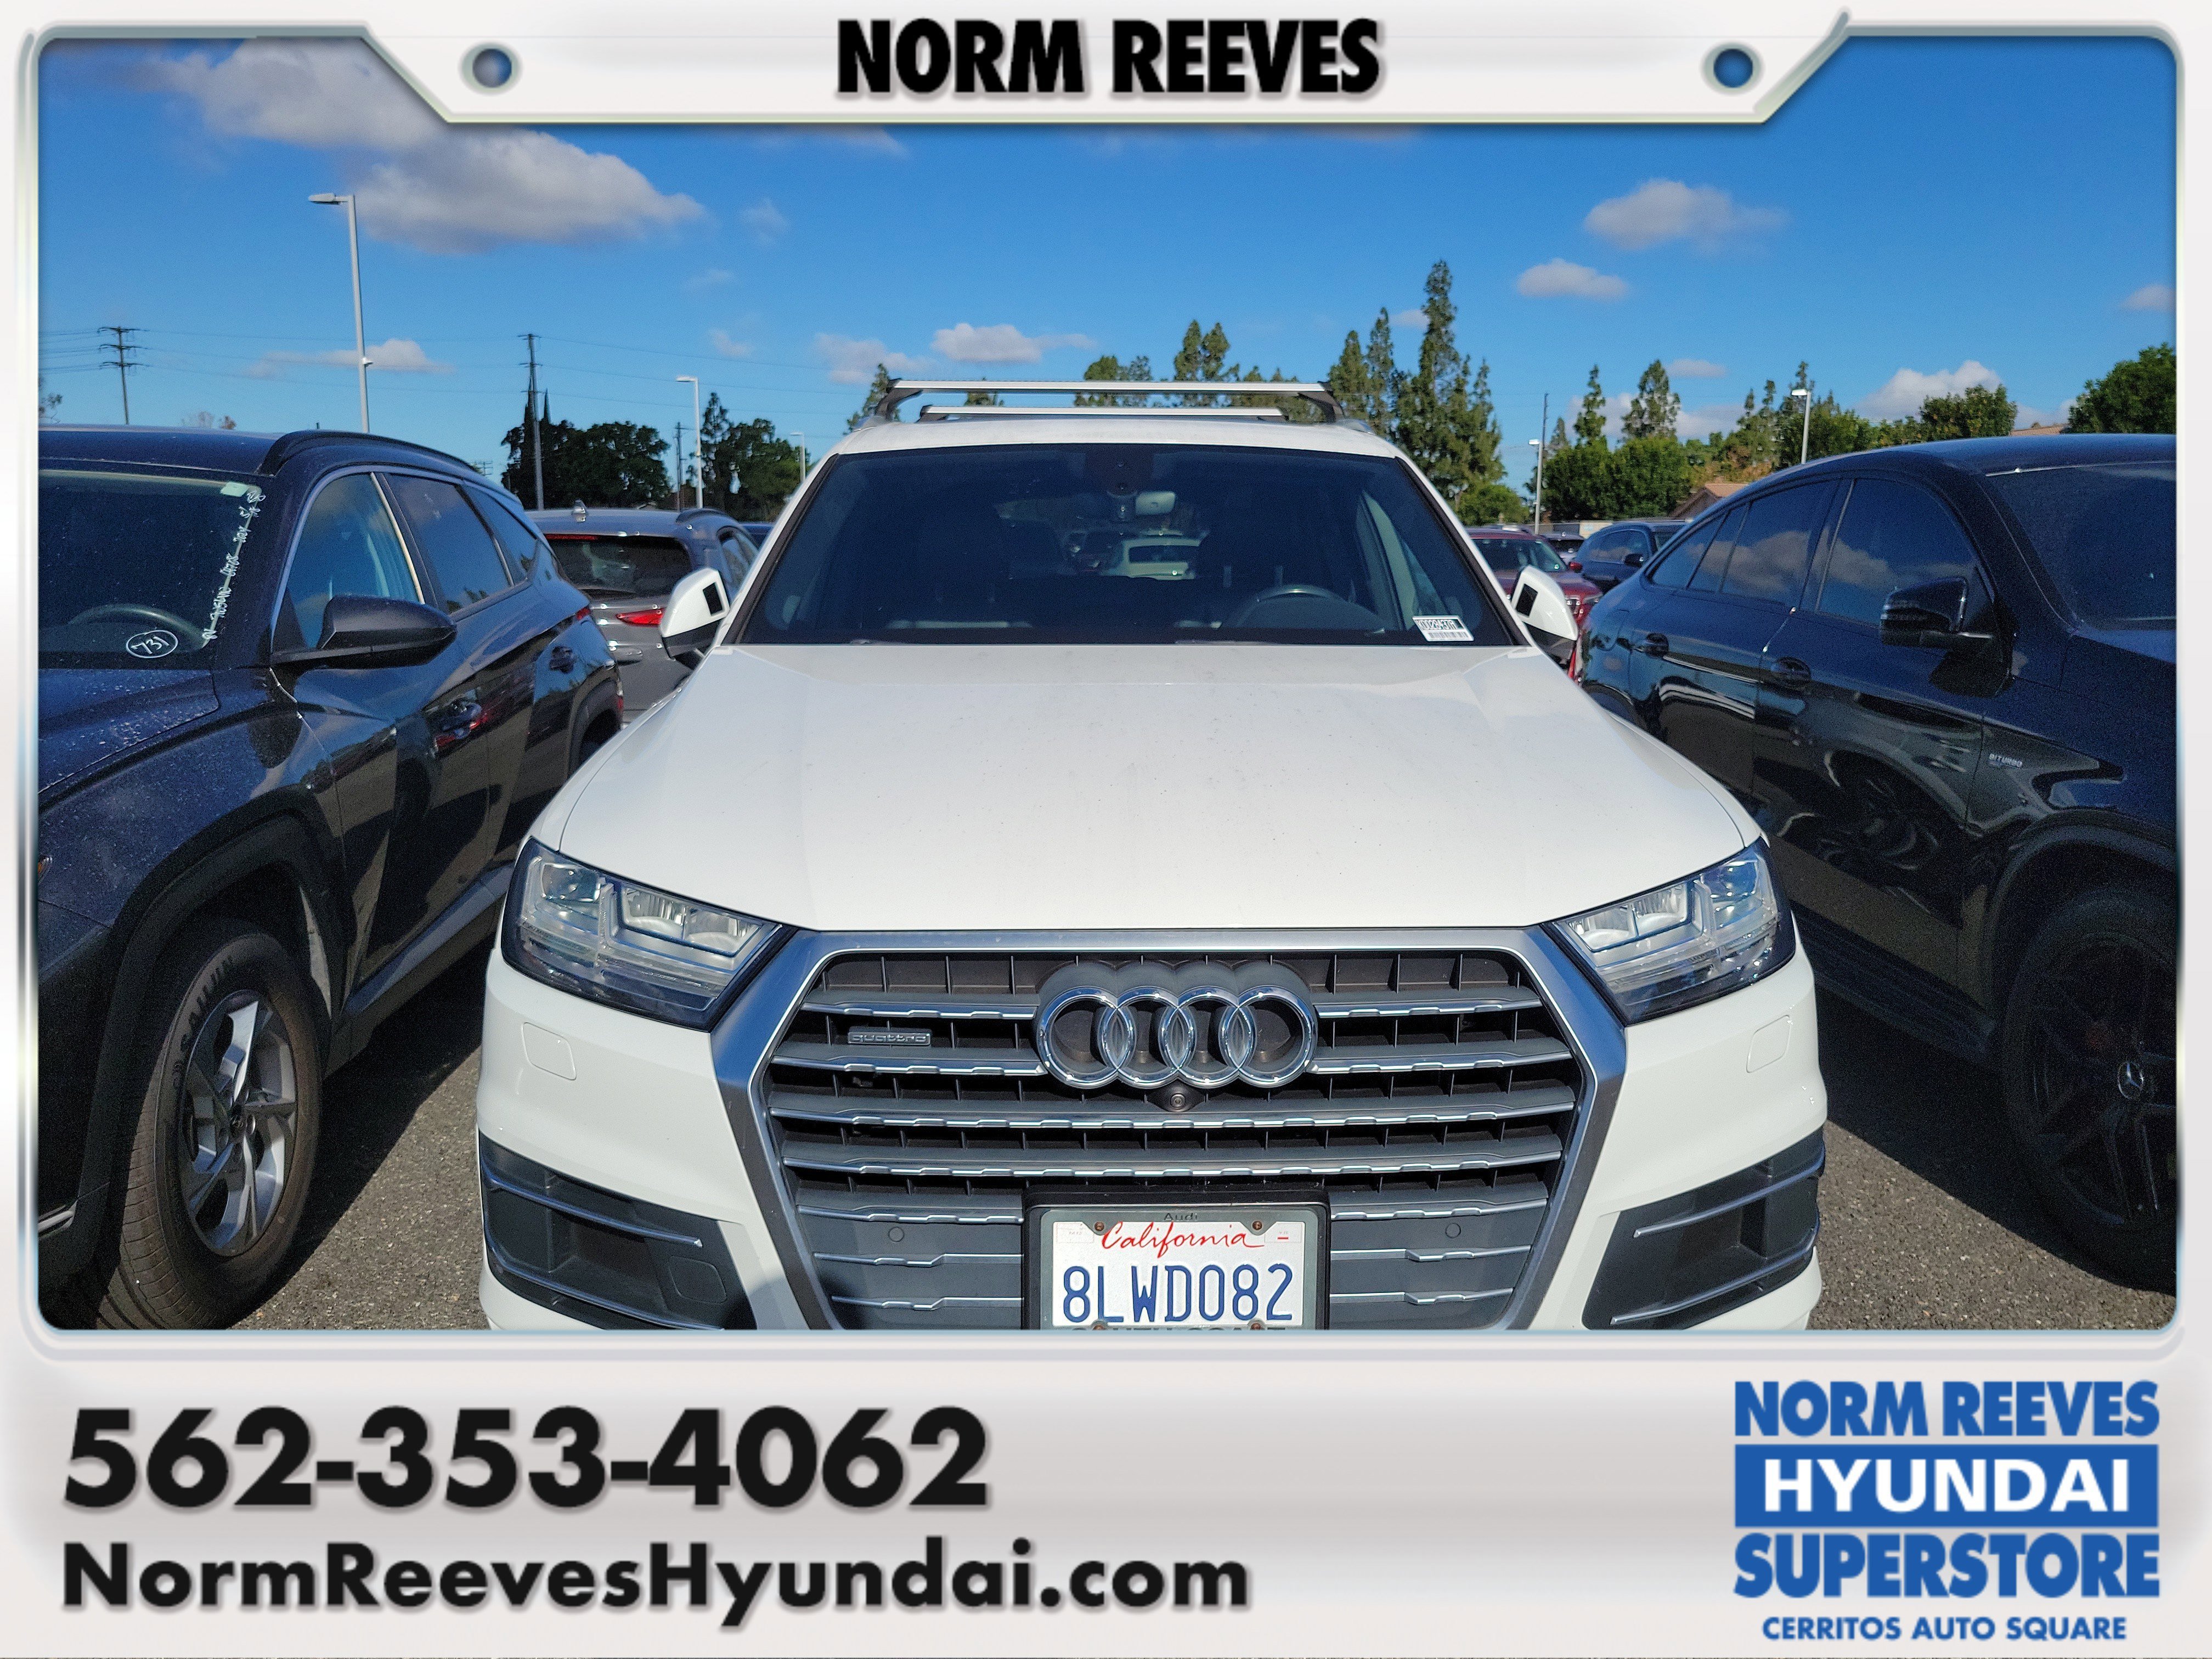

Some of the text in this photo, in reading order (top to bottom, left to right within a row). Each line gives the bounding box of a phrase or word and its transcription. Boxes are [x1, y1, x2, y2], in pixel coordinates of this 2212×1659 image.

[131, 636, 170, 654] 731
[851, 1034, 927, 1043] quattro
[1164, 1212, 1198, 1221] Audi
[1101, 1221, 1265, 1259] California
[1063, 1263, 1293, 1323] 8LWD082
